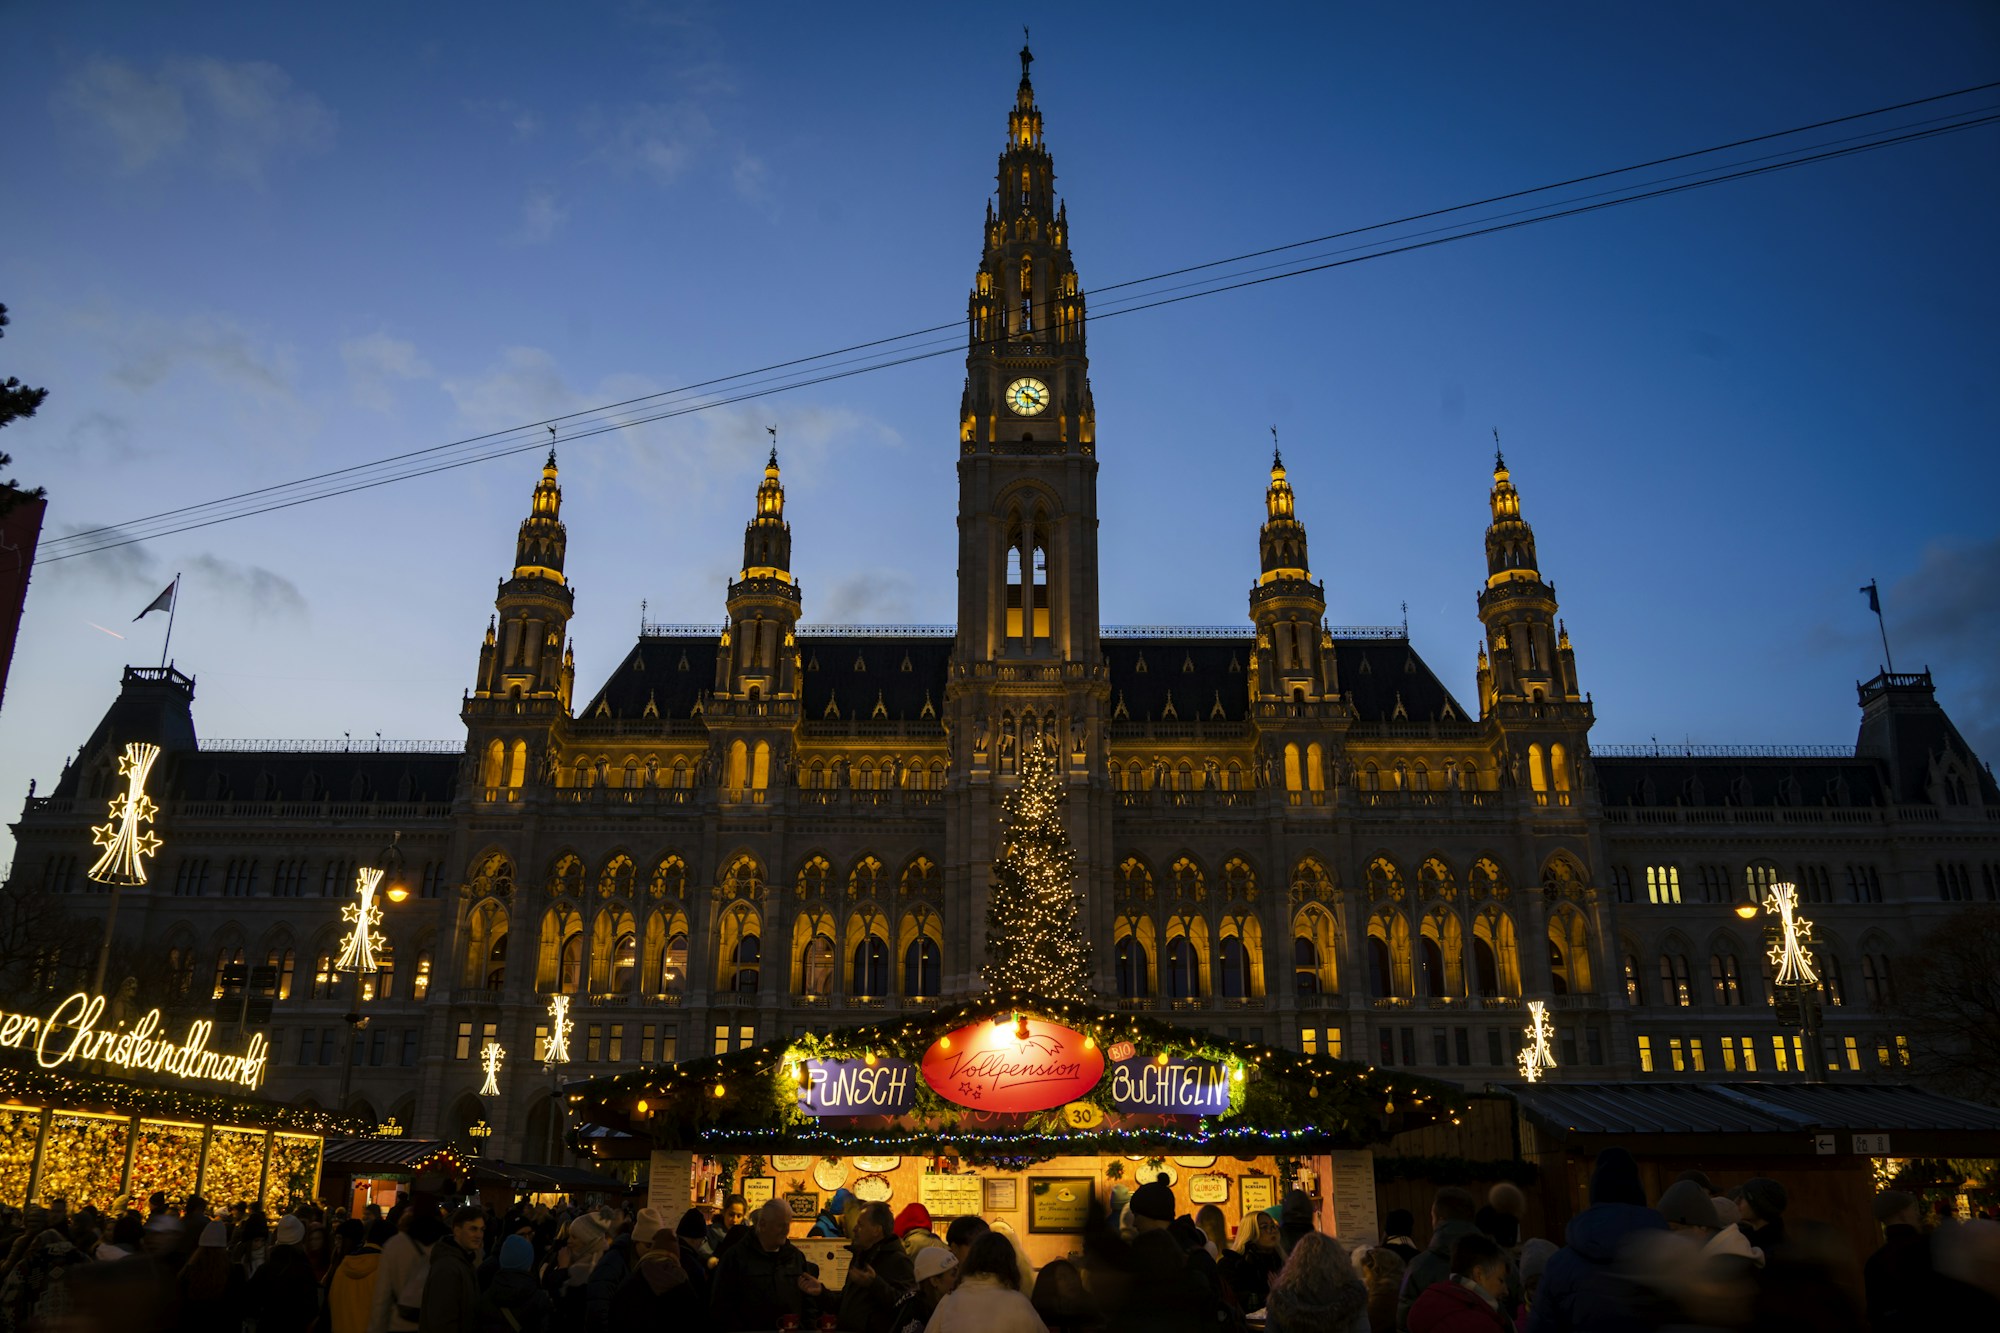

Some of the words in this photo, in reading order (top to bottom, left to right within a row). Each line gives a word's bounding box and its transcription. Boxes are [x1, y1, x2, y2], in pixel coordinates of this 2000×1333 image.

[0, 1010, 40, 1048] er
[37, 992, 269, 1091] Christkindlmarkt
[1111, 1043, 1132, 1060] BIO
[944, 1047, 1081, 1092] Vollpension
[1072, 1109, 1093, 1124] 30
